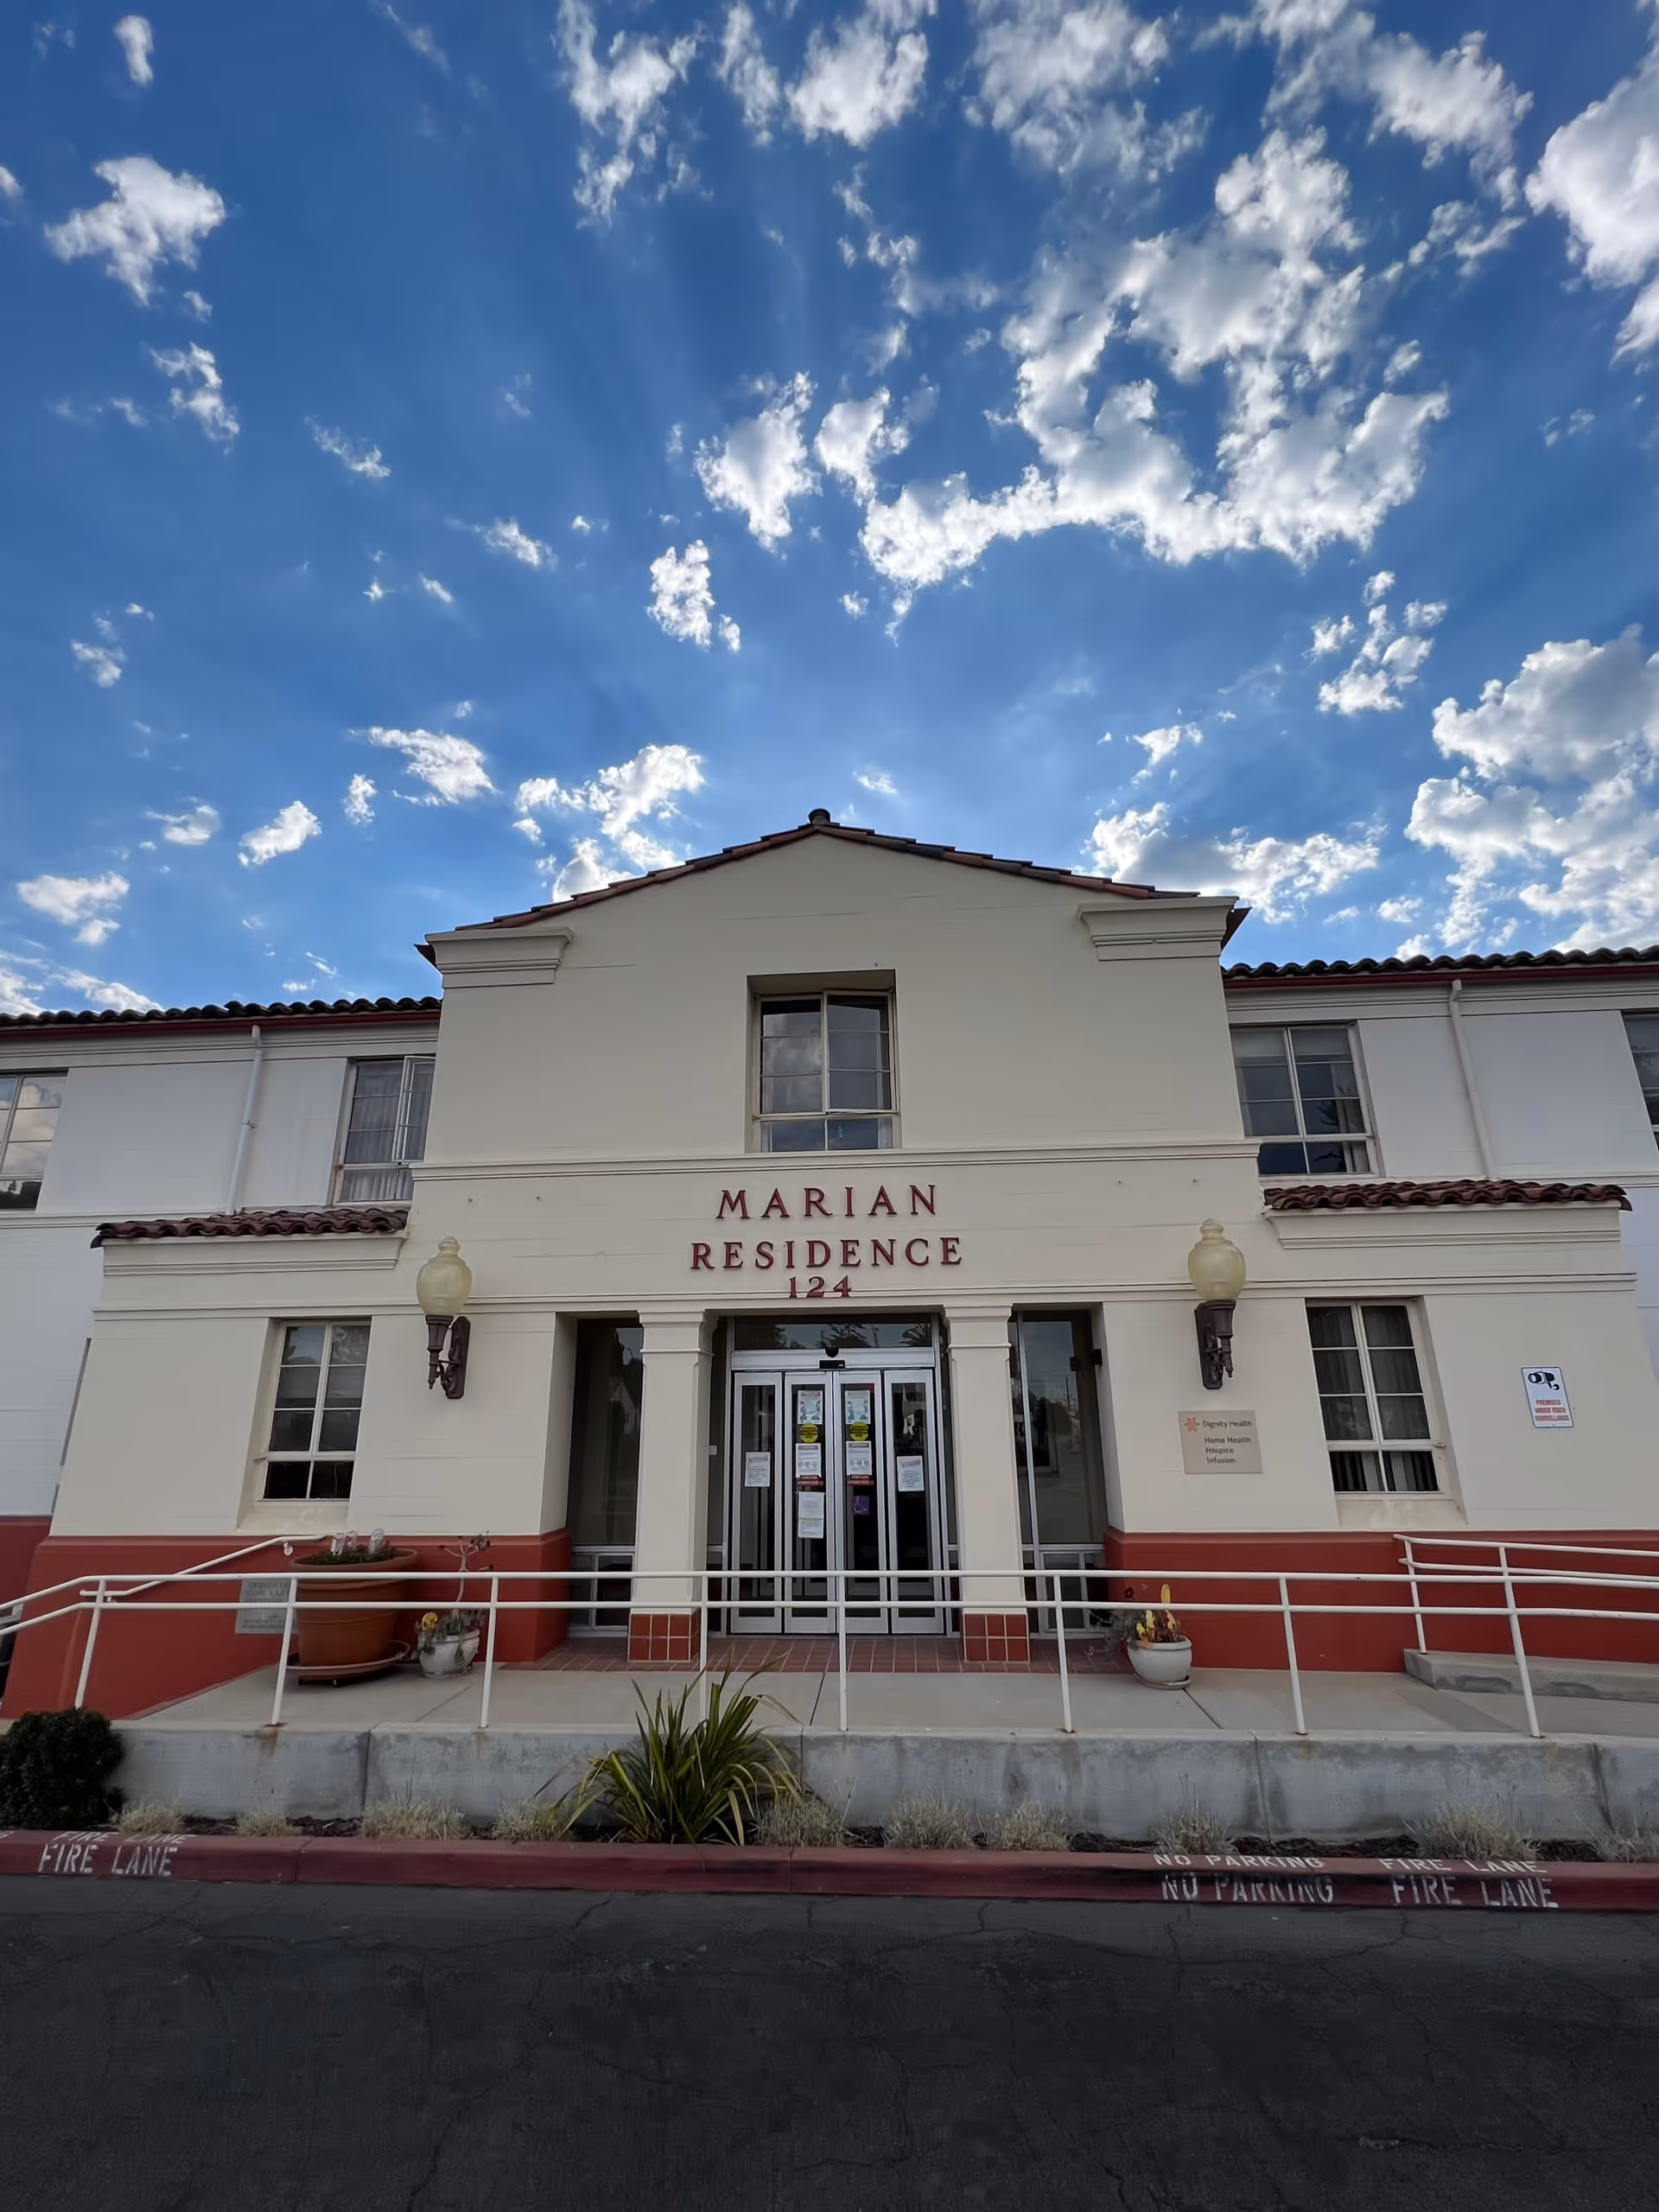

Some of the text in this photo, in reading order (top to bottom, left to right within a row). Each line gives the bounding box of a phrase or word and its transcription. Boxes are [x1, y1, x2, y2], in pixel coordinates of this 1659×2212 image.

[715, 1184, 937, 1219] MARIAN
[690, 1236, 962, 1270] RESIDENCE
[788, 1275, 852, 1299] 124
[1205, 1446, 1235, 1455] Hospice
[52, 1831, 197, 1844] FIRE LANE
[38, 1844, 178, 1876] FIRE LANE
[1154, 1853, 1548, 1873] NO PARKING FIRE LANE
[1162, 1872, 1560, 1908] NO PARKING FIRE LANE
